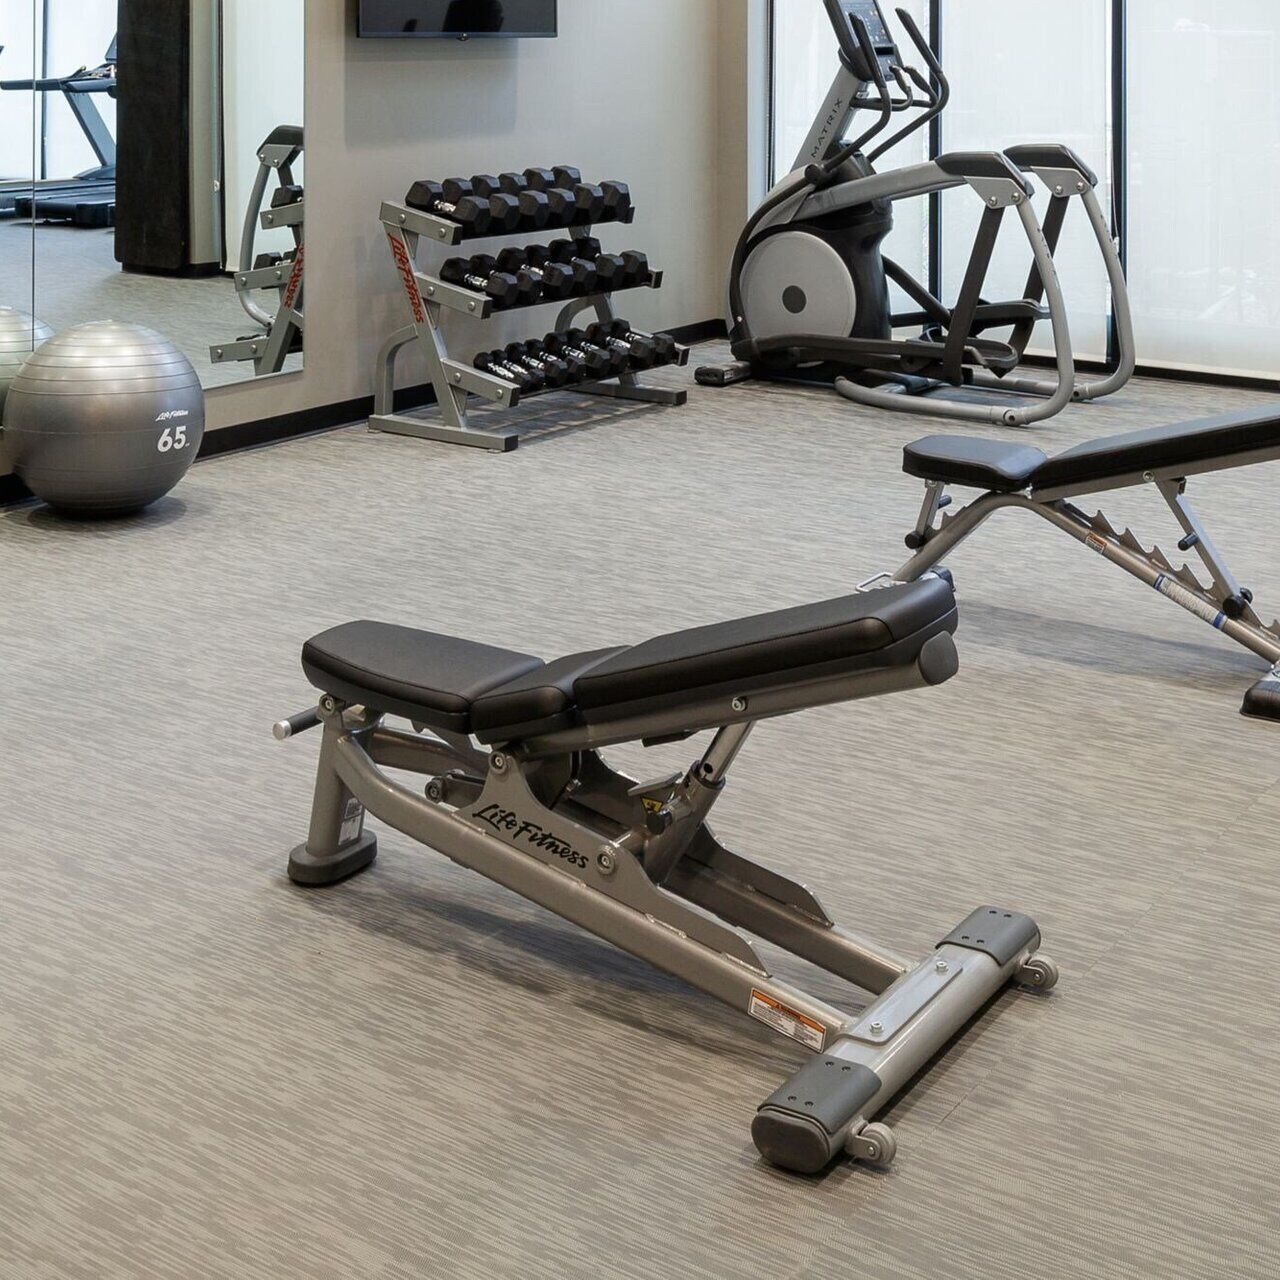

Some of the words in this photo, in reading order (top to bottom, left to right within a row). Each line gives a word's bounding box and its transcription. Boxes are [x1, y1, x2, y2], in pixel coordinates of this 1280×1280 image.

[811, 97, 842, 158] MATRIX
[157, 425, 187, 452] 65
[472, 803, 518, 832] Life
[513, 820, 589, 869] Fitness
